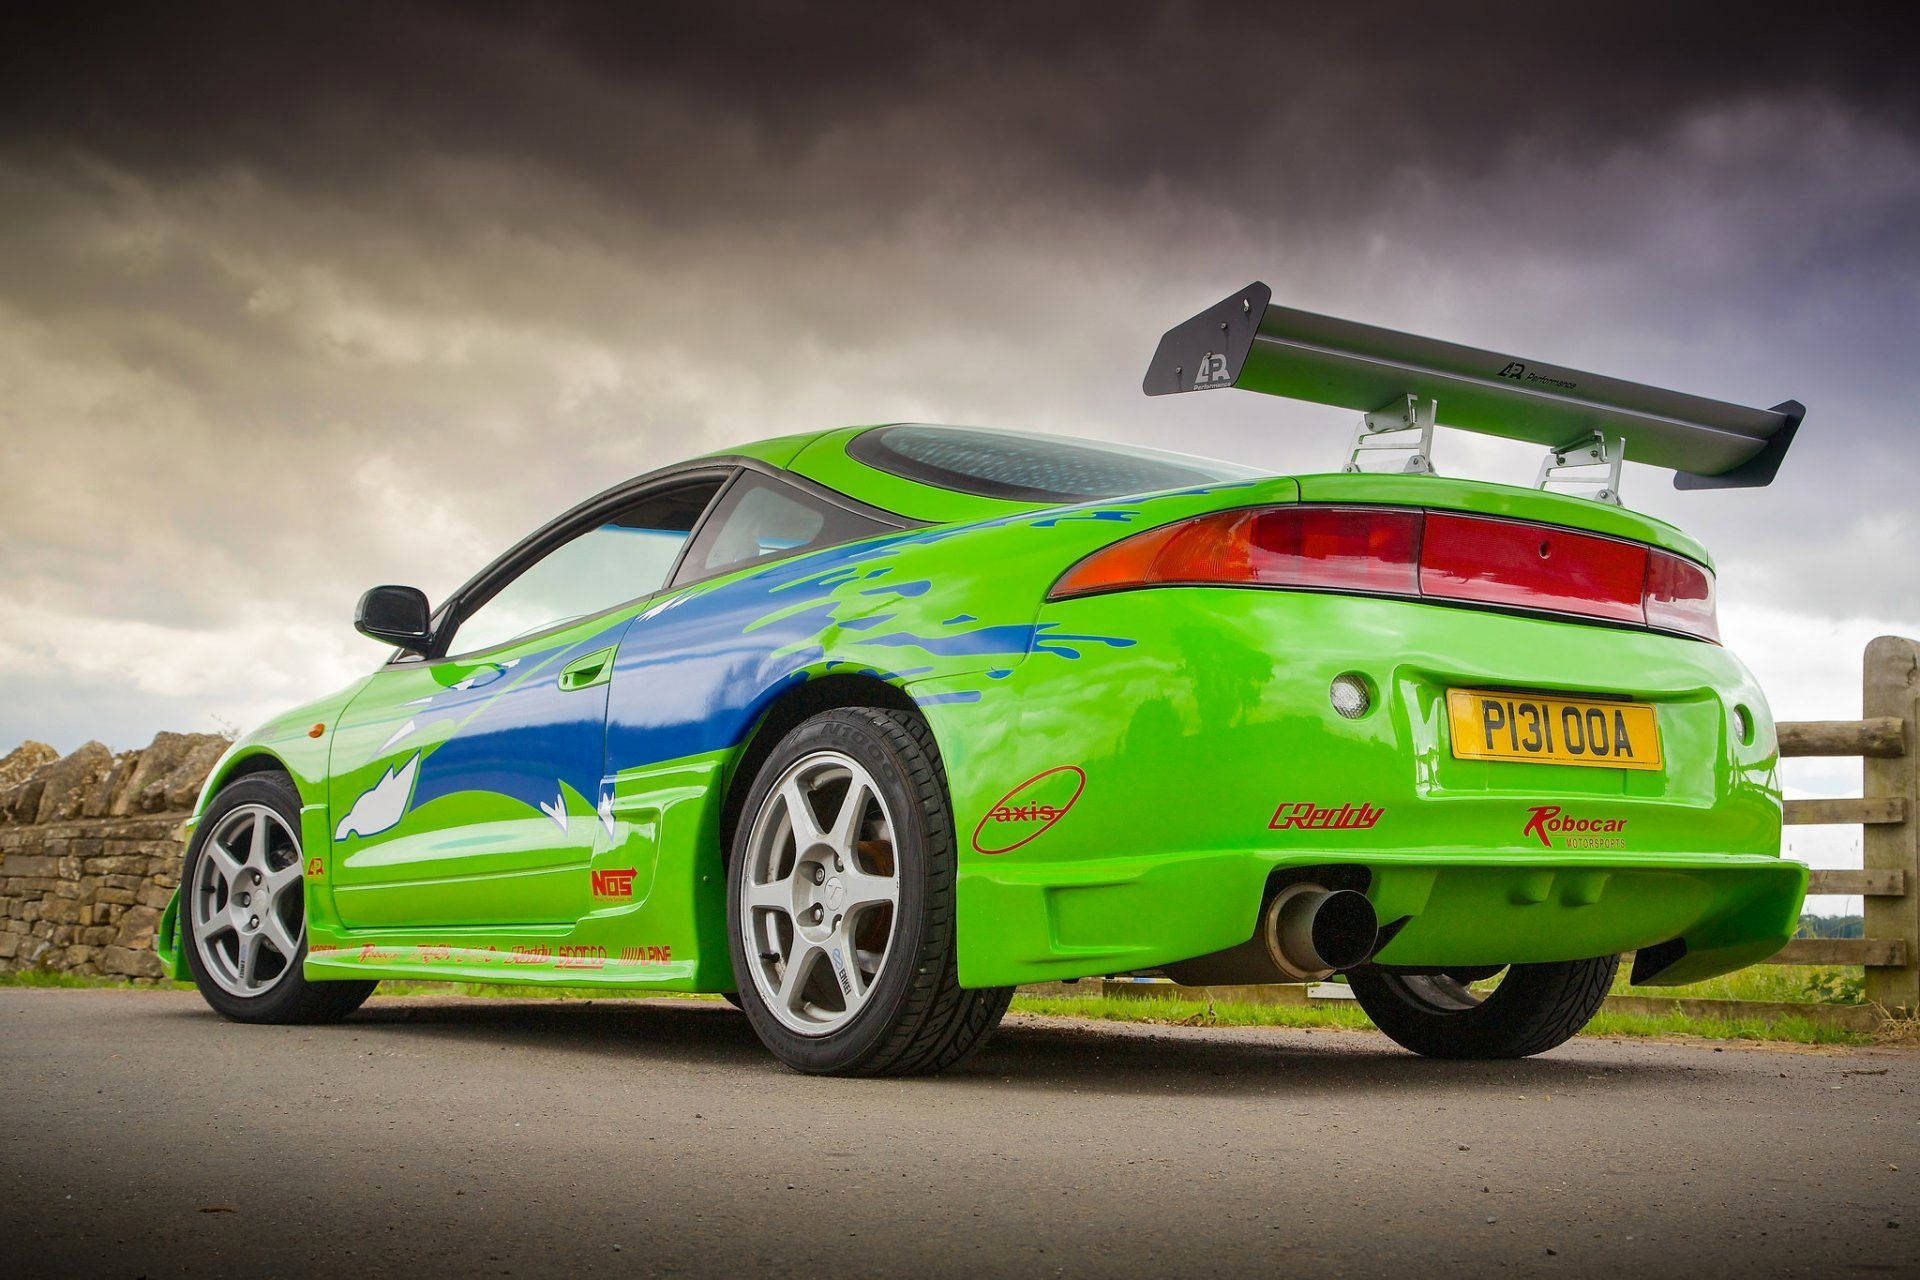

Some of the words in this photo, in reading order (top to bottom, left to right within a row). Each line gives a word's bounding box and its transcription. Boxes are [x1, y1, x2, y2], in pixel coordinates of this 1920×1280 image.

[1526, 372, 1577, 389] Performance
[1481, 700, 1553, 753] P131
[995, 801, 1055, 822] axis
[1267, 802, 1385, 829] GReddy
[1523, 805, 1628, 848] Robocar
[1566, 838, 1626, 848] MOTORSPORTS
[592, 867, 637, 896] NOS
